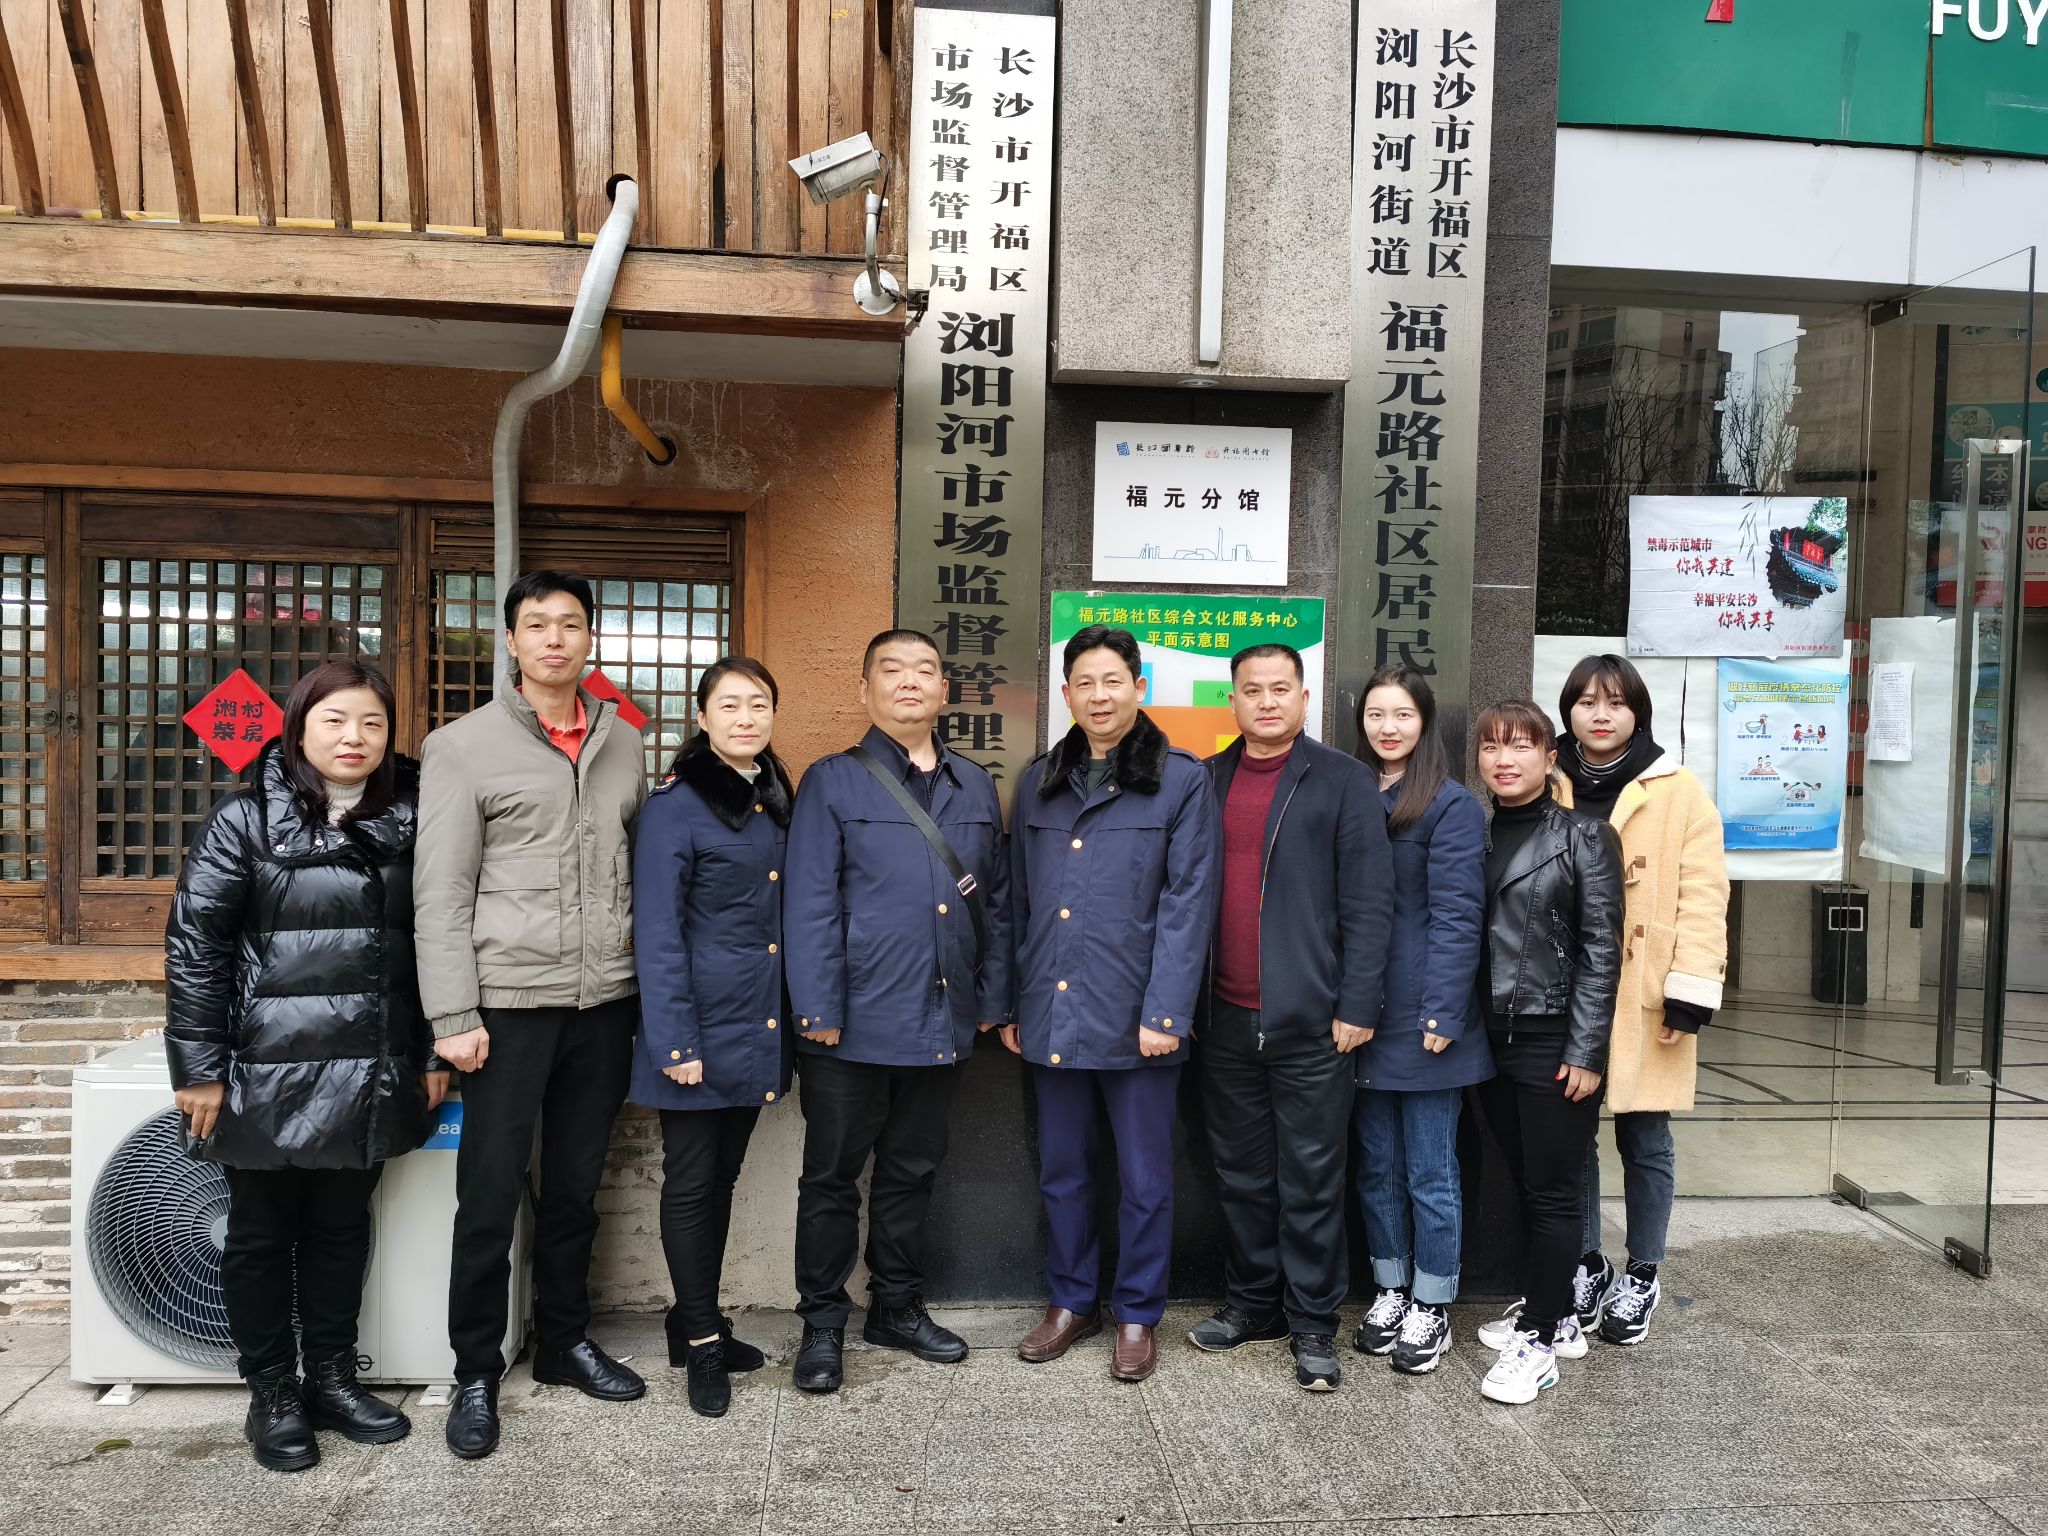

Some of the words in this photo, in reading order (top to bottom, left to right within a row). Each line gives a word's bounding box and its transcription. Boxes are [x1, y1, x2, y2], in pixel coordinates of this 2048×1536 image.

[1367, 27, 1419, 277] 浏阳河街道
[1427, 28, 1478, 279] 长沙市开福区
[927, 43, 973, 292] 市场监督管理局
[989, 46, 1036, 292] 长沙市开福区
[1126, 484, 1260, 511] 福元分馆
[1371, 301, 1448, 677] 福元路社区居民
[932, 311, 1015, 788] 浏阳河市场监督管理
[1647, 537, 1713, 552] 禁毒示范城市
[1676, 555, 1735, 577] 你我共建
[1692, 592, 1758, 607] 幸福平安长沙
[1078, 606, 1298, 628] 福元路社区综合文化服务中心
[1717, 609, 1775, 632] 你我共享
[1146, 631, 1231, 649] 平面示意图
[213, 698, 264, 719] 湘村
